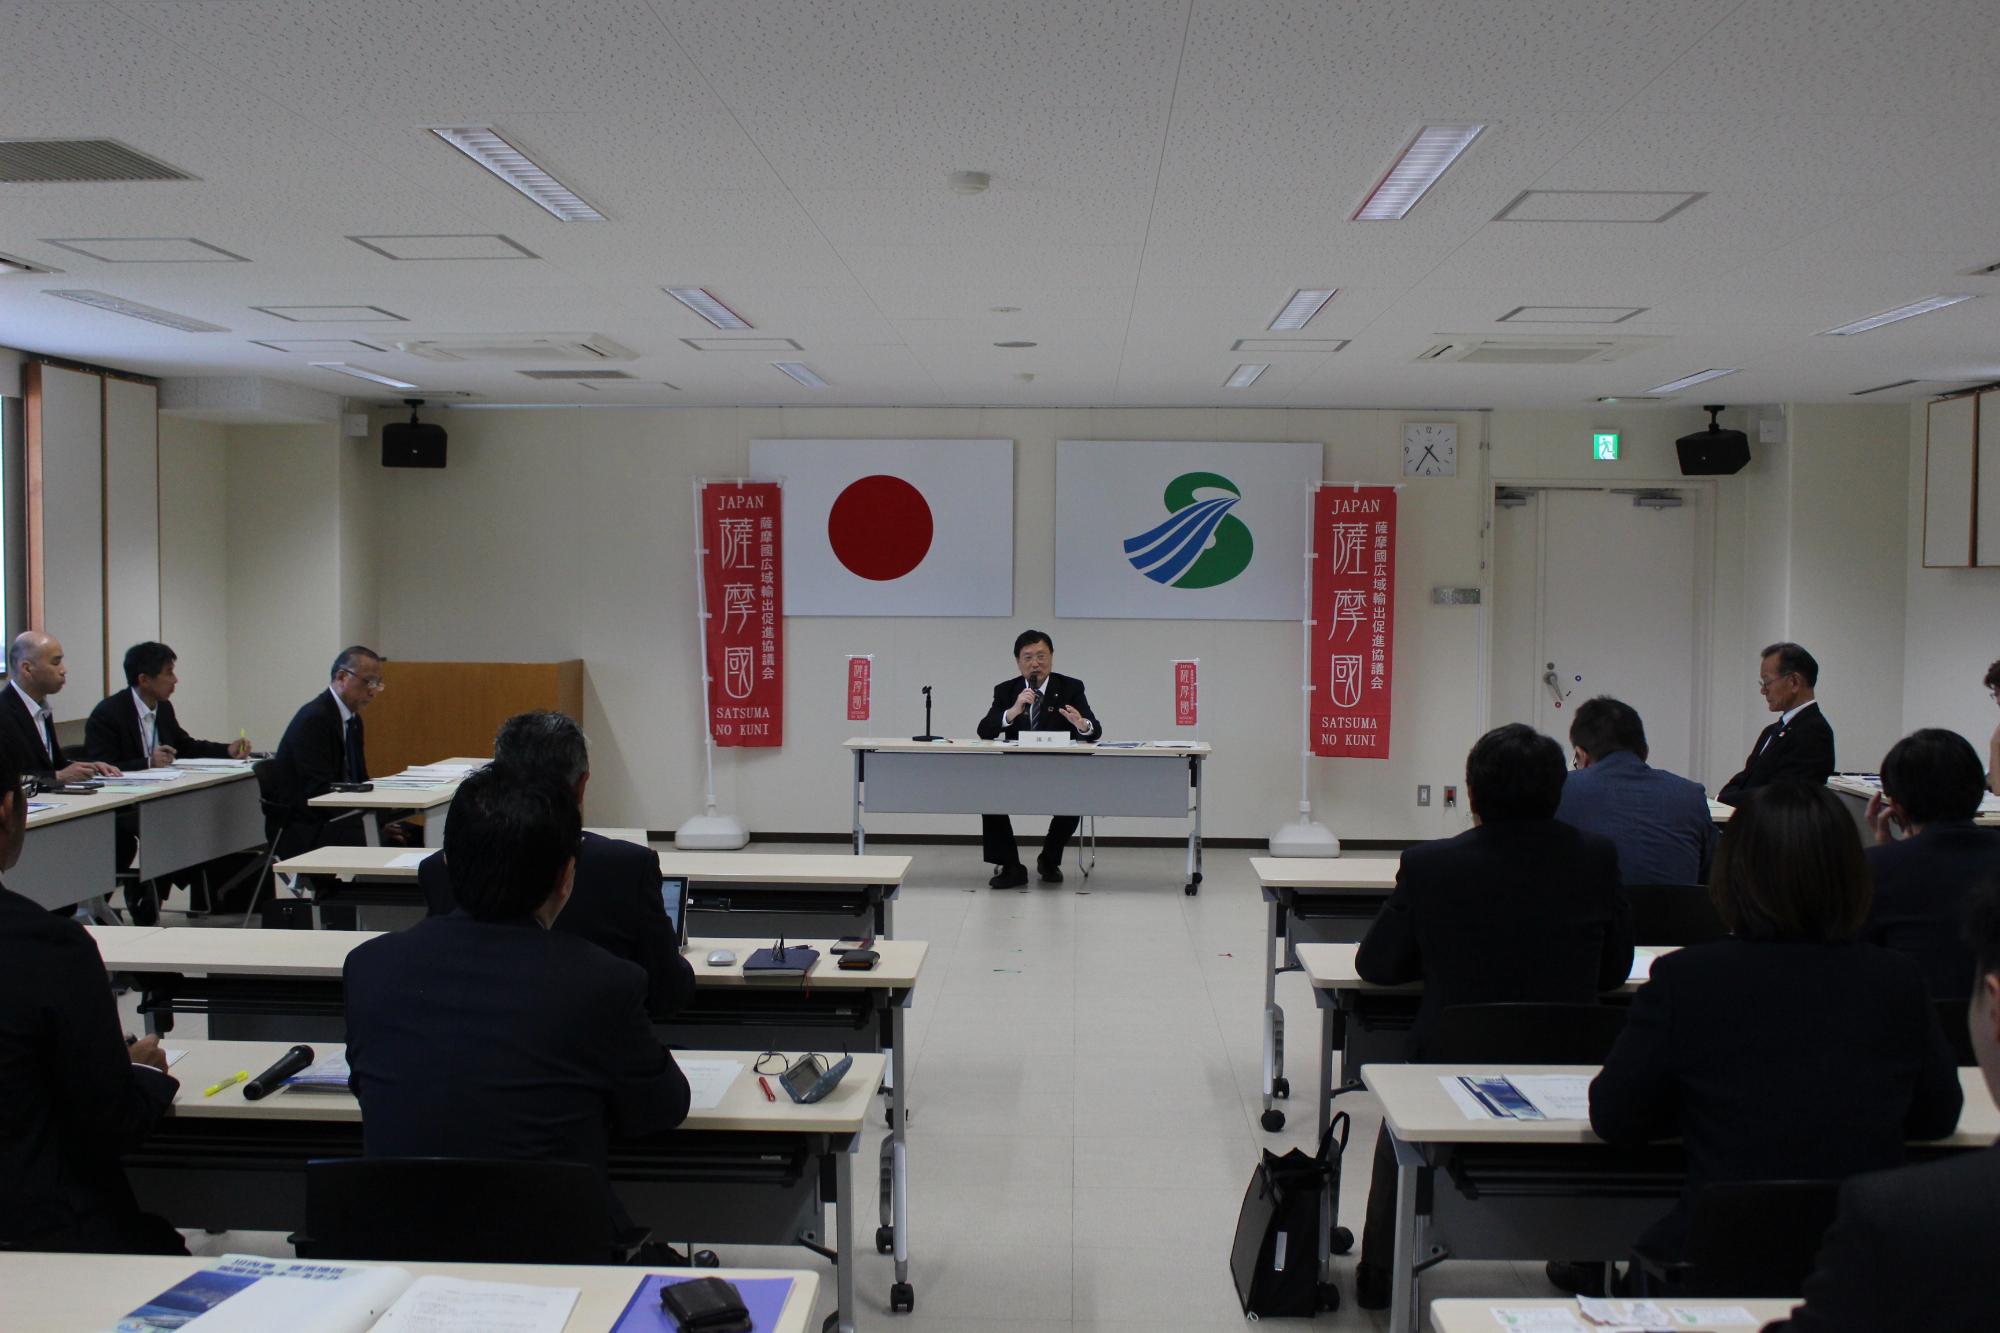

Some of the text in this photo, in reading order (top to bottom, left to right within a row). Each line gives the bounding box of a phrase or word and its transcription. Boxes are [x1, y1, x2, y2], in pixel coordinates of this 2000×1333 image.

[1425, 426, 1432, 434] 12
[1404, 446, 1410, 457] 9
[1447, 447, 1453, 455] 3
[1425, 466, 1432, 476] 6
[718, 495, 764, 511] JAPAN
[1332, 499, 1380, 515] JAPAN
[716, 707, 770, 719] SATSUMA
[1321, 716, 1377, 729] SATSUMA
[716, 723, 769, 736] NO KUNI
[1321, 733, 1376, 747] NO KUNI
